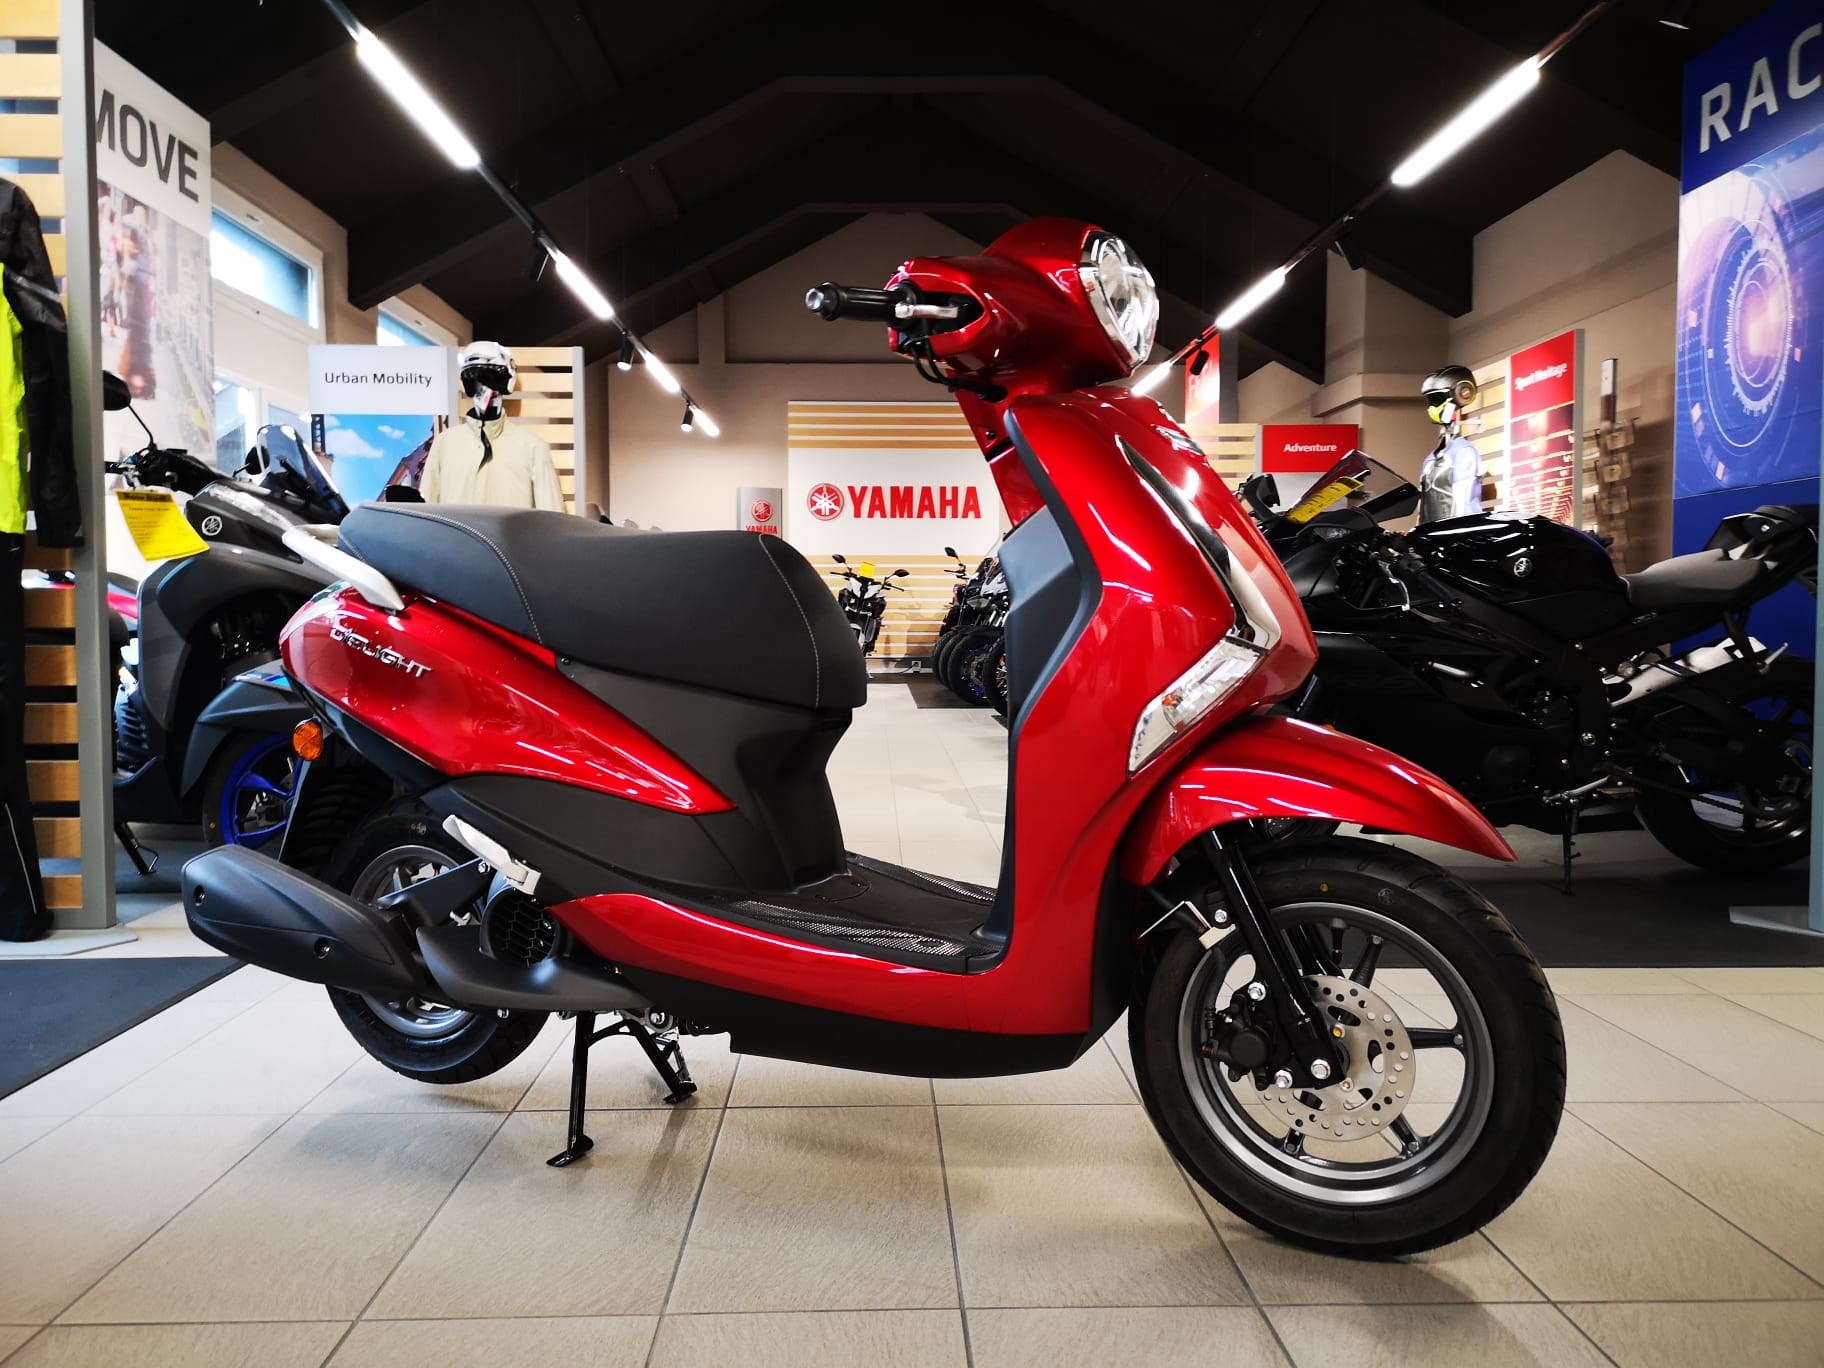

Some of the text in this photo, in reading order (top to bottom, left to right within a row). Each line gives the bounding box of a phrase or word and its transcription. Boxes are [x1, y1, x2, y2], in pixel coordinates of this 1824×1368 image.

[325, 372, 432, 388] Urban Mobility
[1283, 442, 1337, 453] Adventure
[847, 485, 982, 519] YAMAHA
[745, 525, 778, 535] YAMAHA
